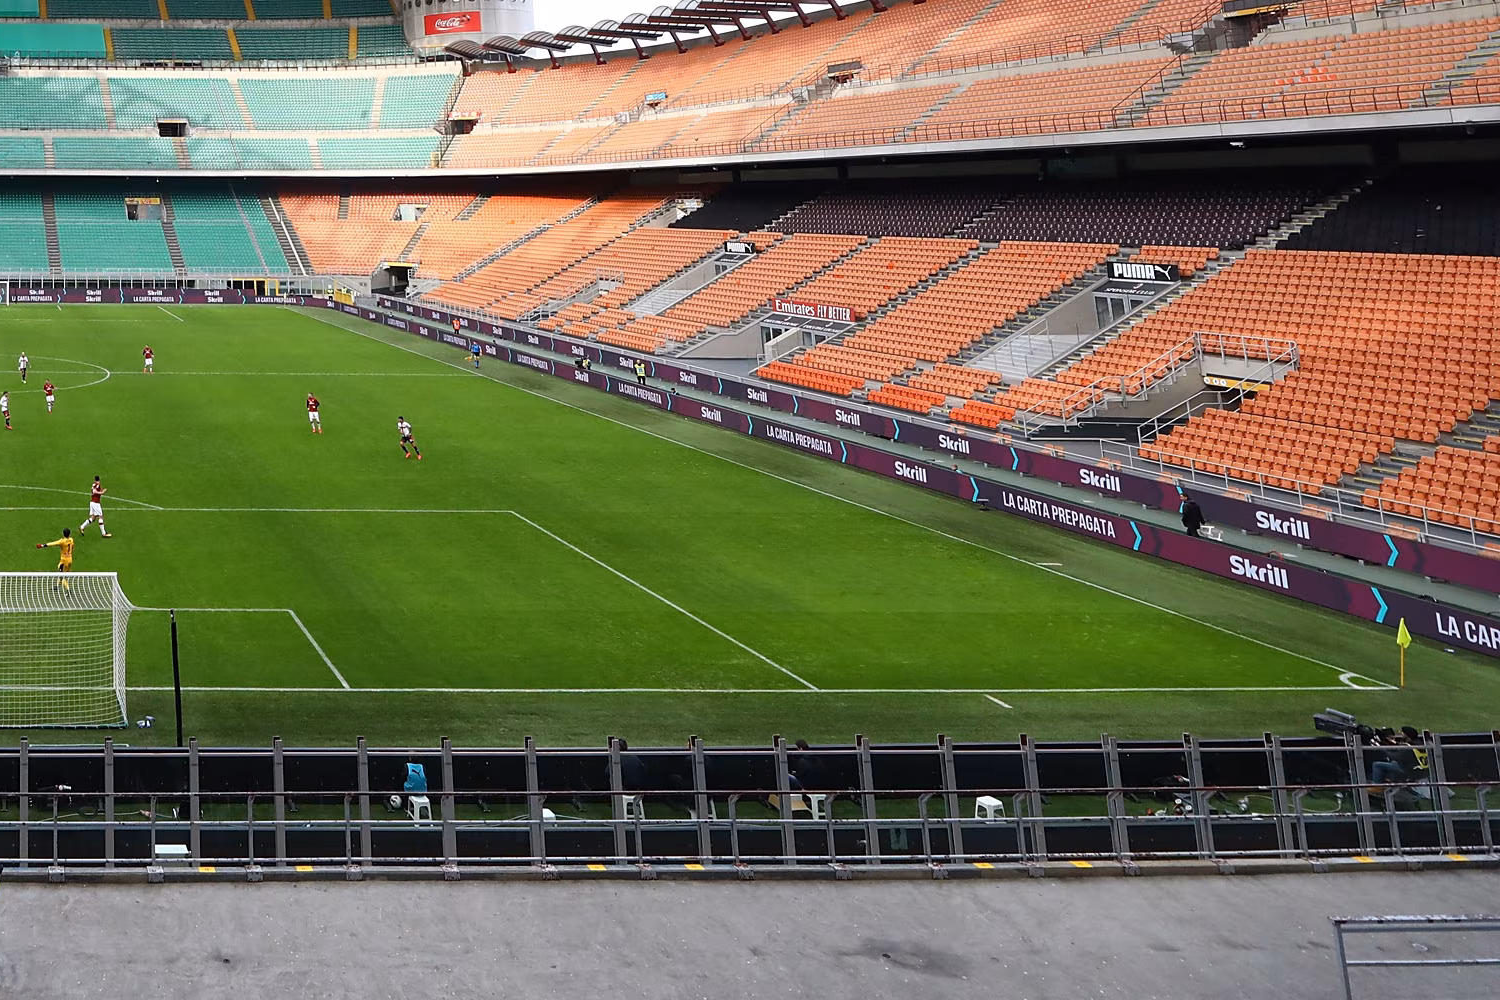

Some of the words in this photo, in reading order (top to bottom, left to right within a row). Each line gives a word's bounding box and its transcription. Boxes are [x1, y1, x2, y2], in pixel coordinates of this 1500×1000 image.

[726, 242, 745, 253] PUMA
[1113, 262, 1156, 279] PUMA
[775, 299, 815, 316] Emirates
[817, 305, 827, 317] FLY
[828, 306, 851, 321] BETTER
[571, 345, 584, 356] Skrill
[619, 356, 634, 369] Skrill
[574, 370, 589, 383] Skrill
[679, 371, 697, 385] Skrill
[747, 388, 768, 403] Skrill
[701, 406, 722, 423] Skrill
[835, 409, 861, 427] Skrill
[766, 424, 775, 437] LA
[775, 426, 794, 443] CARTA
[795, 432, 833, 455] PREPAGATA
[938, 434, 970, 454] Skrill
[894, 460, 927, 483] Skrill
[1079, 468, 1121, 492] Skrill
[1002, 490, 1016, 509] LA
[1017, 496, 1050, 520] CARTA
[1051, 504, 1116, 538] PREPAGATA
[1255, 510, 1310, 540] Skrill
[1228, 554, 1290, 589] Skrill
[1435, 611, 1461, 639] LA
